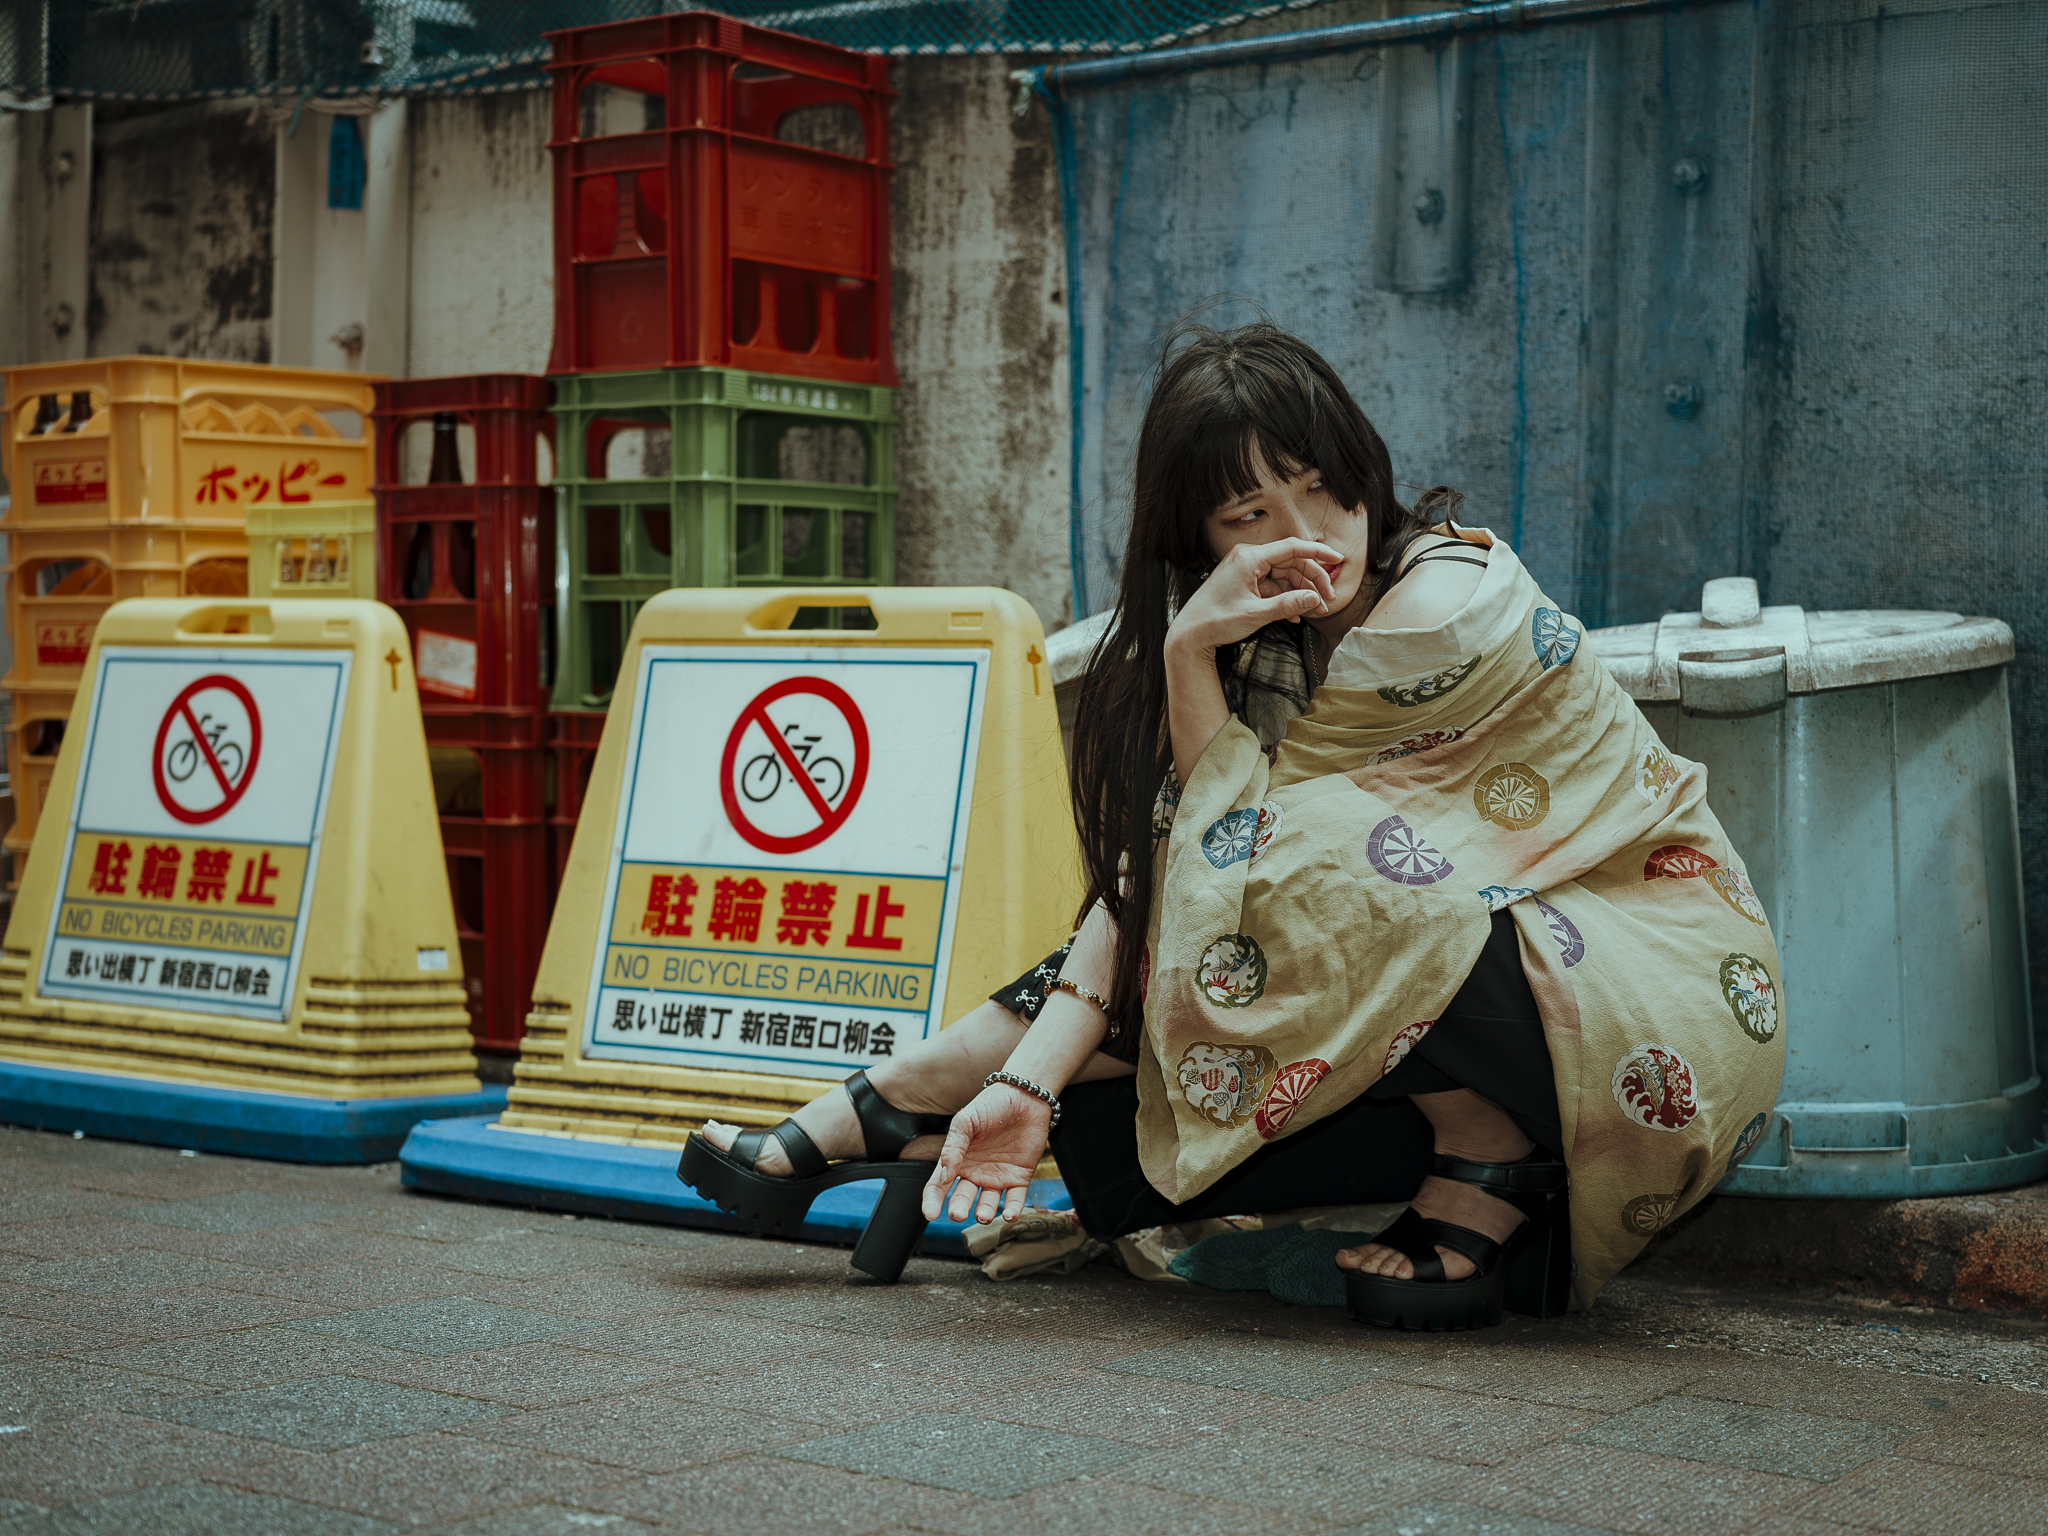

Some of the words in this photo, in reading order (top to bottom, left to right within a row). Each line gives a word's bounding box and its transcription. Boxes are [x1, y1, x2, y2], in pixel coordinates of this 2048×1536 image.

[196, 458, 346, 504] ホッピー
[88, 840, 279, 907] 駐輪禁止
[65, 907, 93, 932] NO
[101, 910, 193, 941] BICYCLES
[197, 919, 286, 949] PARKING
[641, 872, 905, 951] 駐輪禁止
[65, 948, 154, 984] 思い出横丁
[159, 958, 271, 996] 新宿西口柳会
[614, 954, 649, 979] NO
[663, 957, 788, 991] BICYCLES
[796, 965, 919, 1001] PARKING
[612, 999, 732, 1040] 思い出横丁
[740, 1008, 896, 1057] 新宿西口柳会
